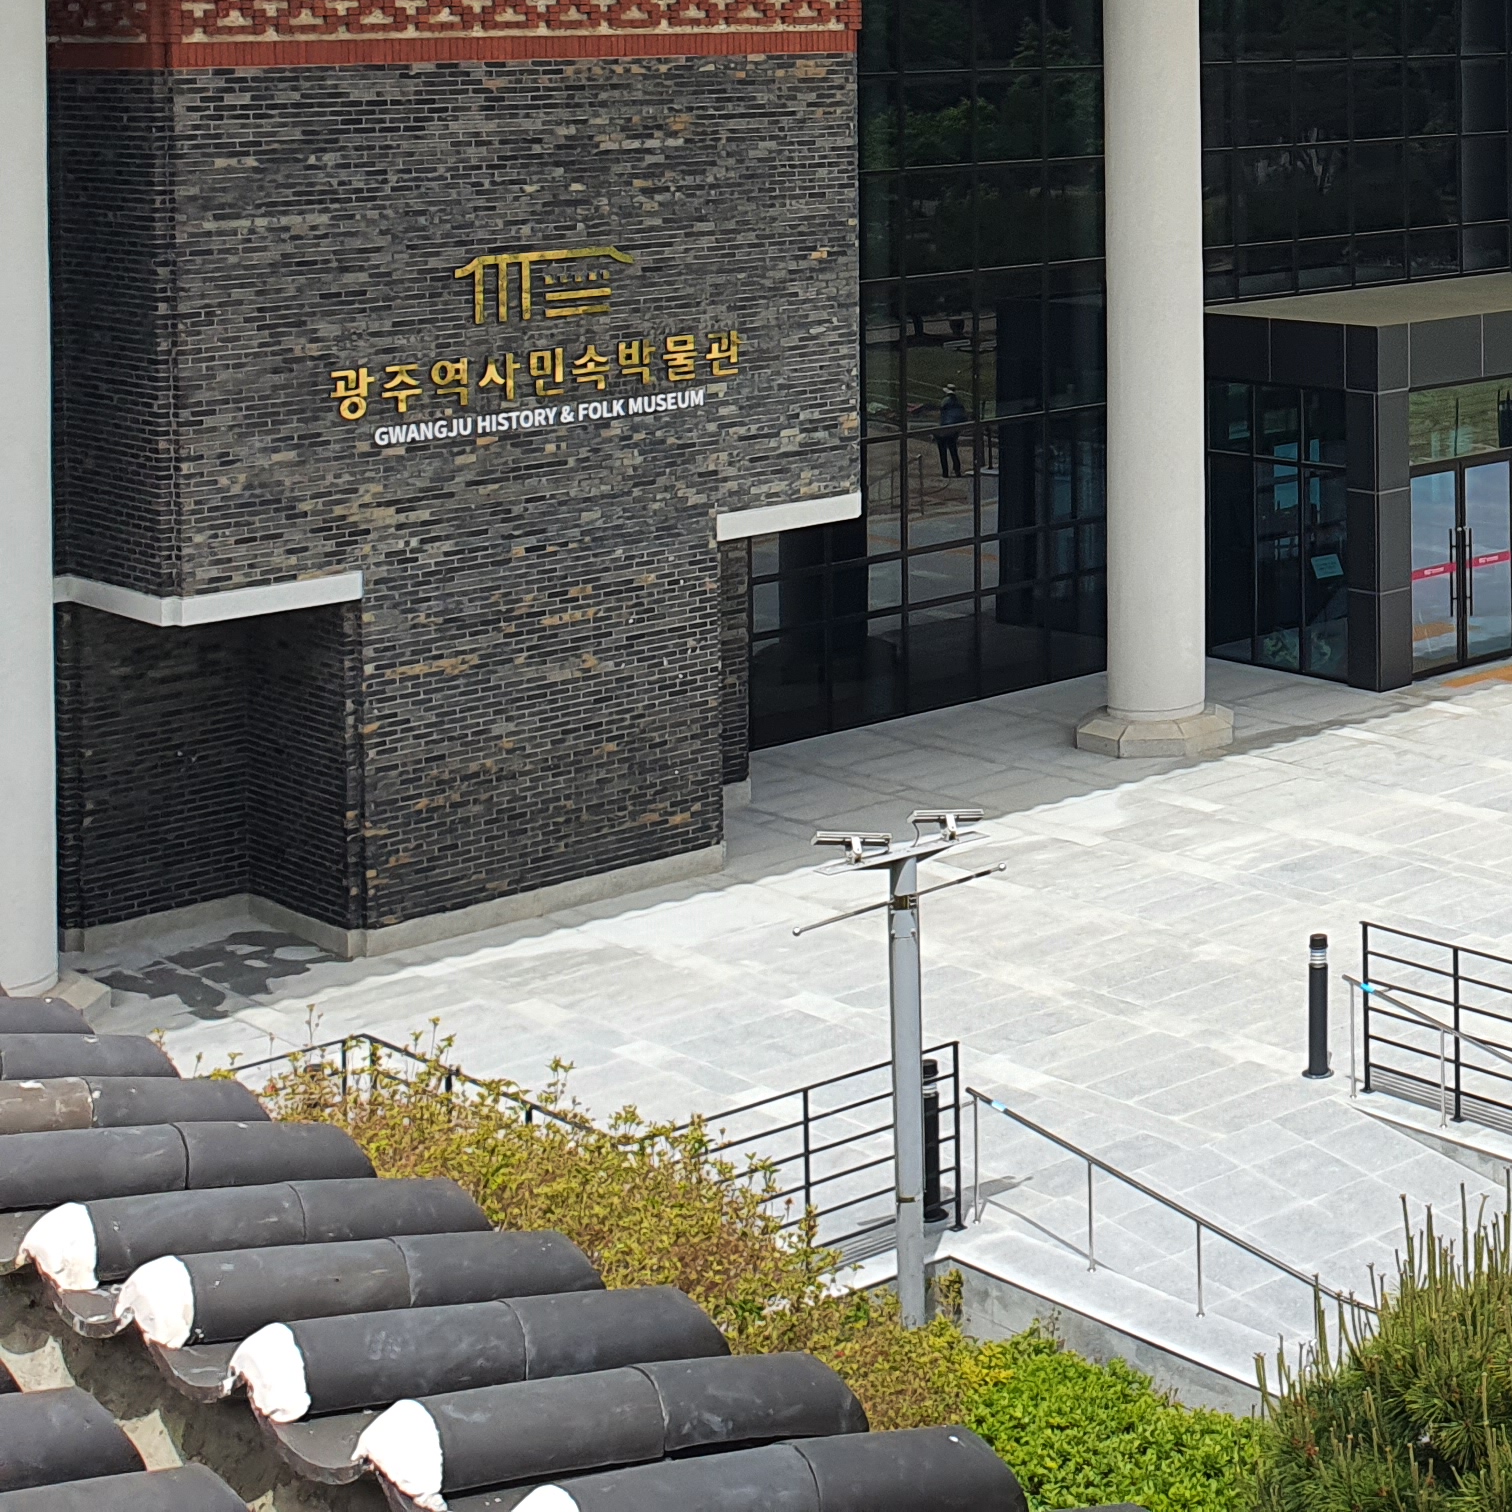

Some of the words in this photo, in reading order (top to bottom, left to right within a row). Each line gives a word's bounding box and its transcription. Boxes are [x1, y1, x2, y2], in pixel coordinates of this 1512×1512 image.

[330, 330, 741, 419] 광주역사민속박물관
[374, 417, 473, 446] GWANGJU
[476, 406, 556, 434] HISTORY
[560, 404, 575, 424] &
[578, 397, 626, 420] FOLK
[628, 389, 705, 416] MUSEUM
